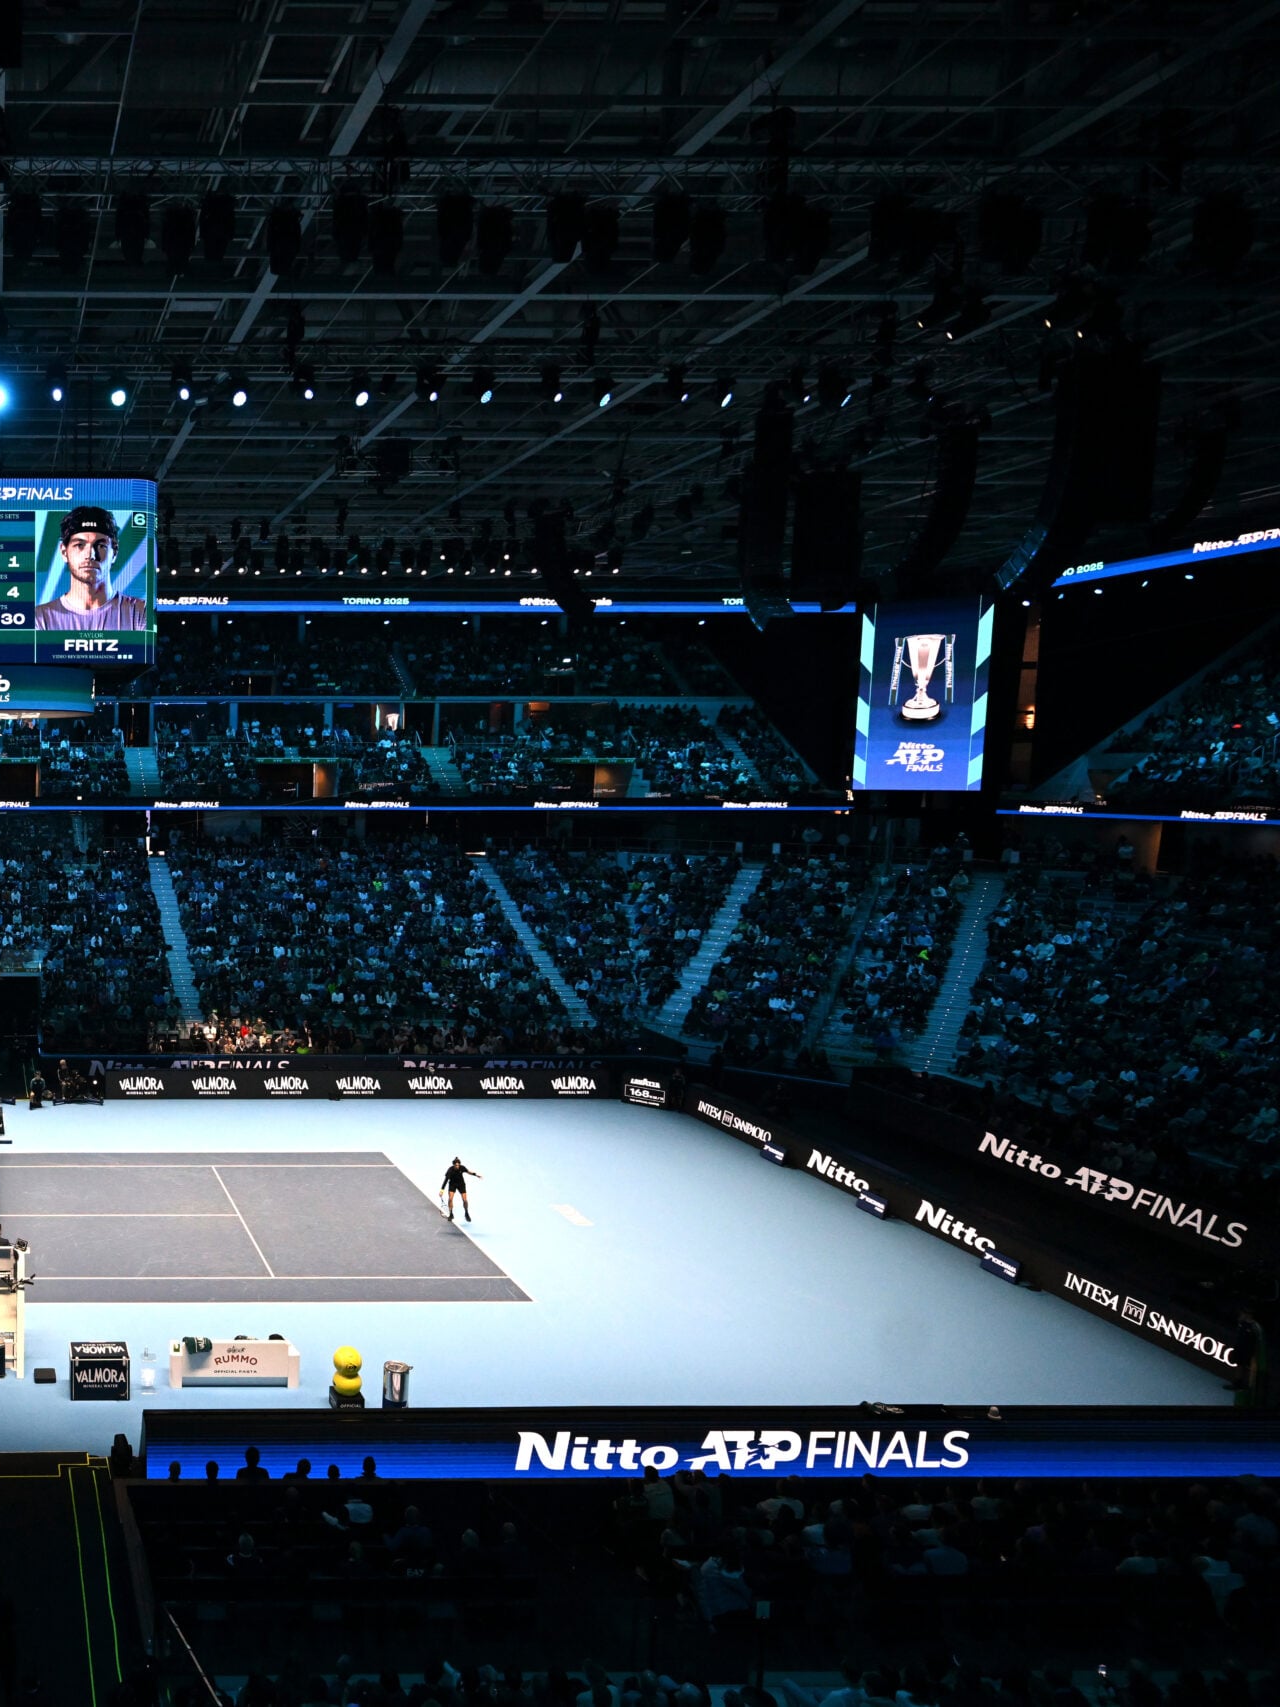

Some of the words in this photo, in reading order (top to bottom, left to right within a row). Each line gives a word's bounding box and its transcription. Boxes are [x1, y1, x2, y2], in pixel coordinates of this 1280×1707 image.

[16, 487, 74, 500] FINALS
[133, 514, 146, 526] 6
[1192, 541, 1234, 554] Nitto
[8, 556, 20, 568] 1
[1076, 562, 1104, 575] 2025
[6, 586, 20, 598] 4
[197, 597, 229, 605] FINALS
[0, 613, 26, 625] 30
[64, 640, 119, 652] FRITZ
[898, 742, 936, 750] Nitto
[884, 750, 945, 765] ATP
[905, 764, 943, 772] FINALS
[1234, 813, 1267, 822] FINALS
[119, 1077, 164, 1091] VALMORA
[192, 1077, 237, 1091] VALMORA
[264, 1077, 309, 1091] VALMORA
[335, 1077, 381, 1091] VALMORA
[408, 1076, 453, 1091] VALMORA
[480, 1076, 525, 1091] VALMORA
[551, 1076, 597, 1090] VALMORA
[629, 1088, 650, 1098] 168
[697, 1101, 721, 1121] INTESA
[732, 1117, 772, 1142] SANPAOLO
[806, 1149, 870, 1192] Nitto
[978, 1132, 1062, 1179] Nitto
[1063, 1166, 1134, 1201] ATP
[1131, 1188, 1248, 1248] FINALS
[915, 1200, 996, 1252] Nitto
[1063, 1272, 1119, 1312] INTESA
[74, 1346, 125, 1354] VALMORA
[214, 1355, 258, 1365] RUMMO
[75, 1368, 126, 1383] VALMORA
[514, 1432, 679, 1471] Nitto
[683, 1431, 802, 1471] ATP
[804, 1431, 970, 1469] FINALS
